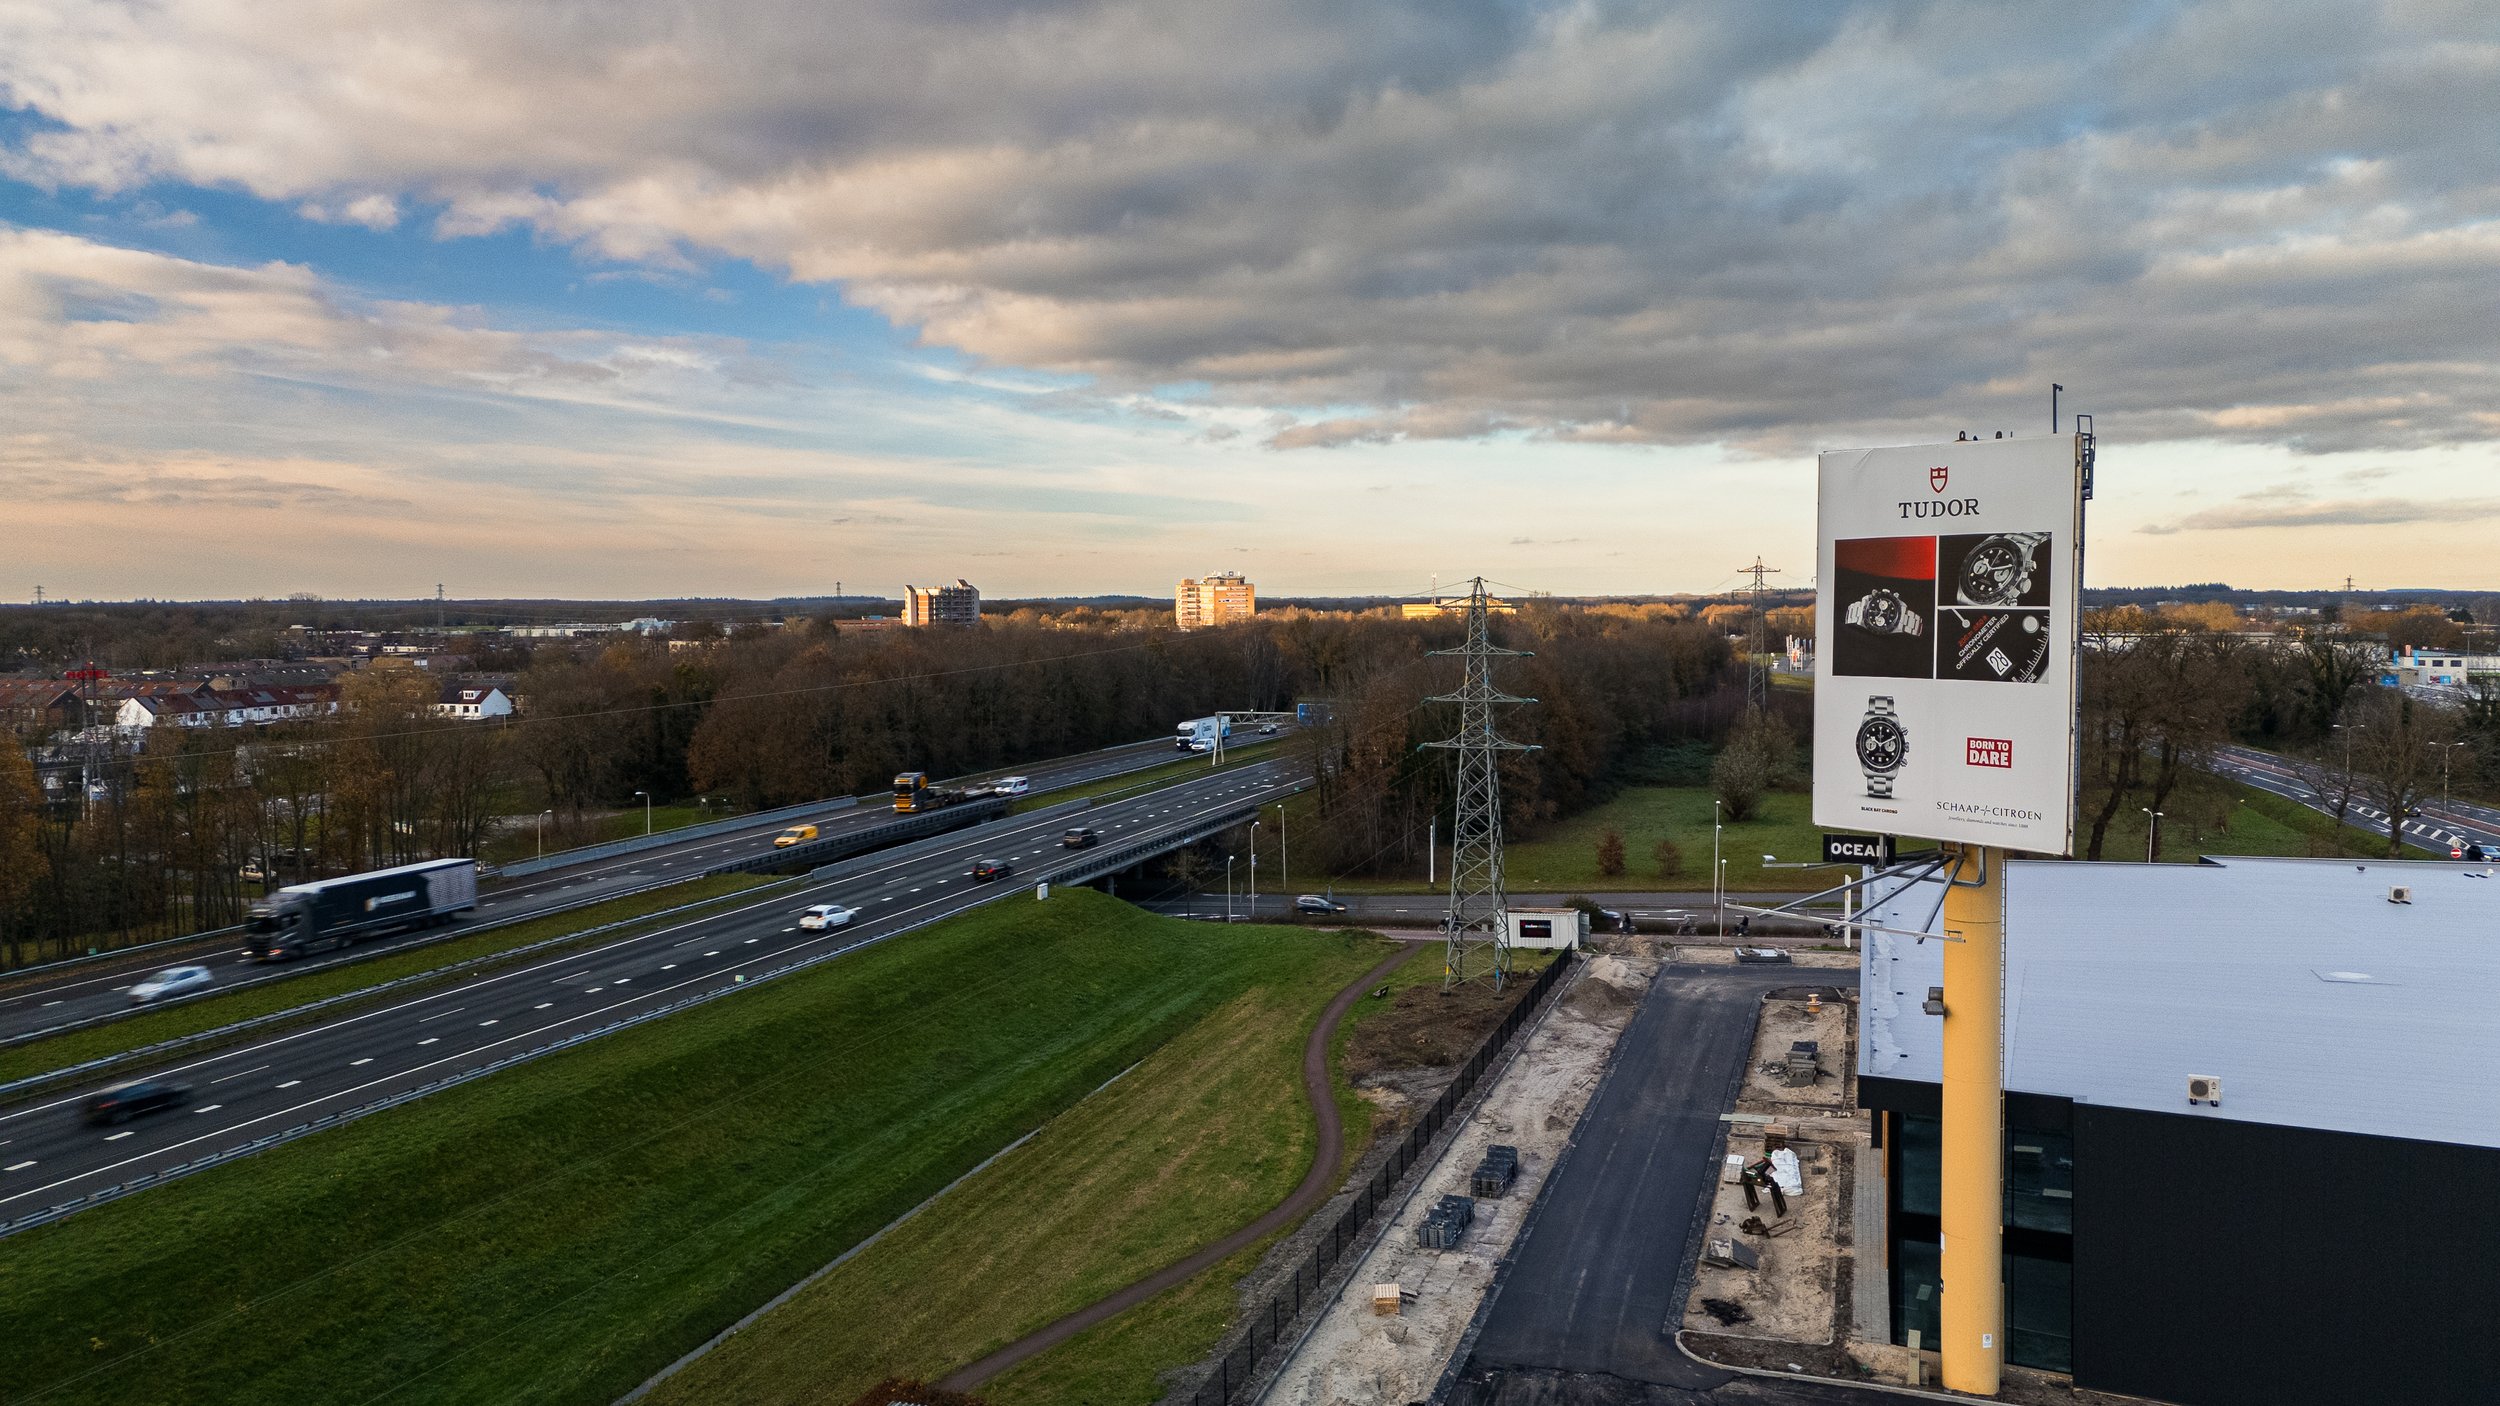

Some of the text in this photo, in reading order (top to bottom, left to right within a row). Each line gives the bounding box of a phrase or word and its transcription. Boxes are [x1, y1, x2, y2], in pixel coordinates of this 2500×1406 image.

[1898, 498, 1980, 519] TUDOR
[1956, 640, 1984, 670] OFFICIALLY
[1982, 613, 2010, 642] CERTIFIED
[1958, 616, 1997, 657] CHRONOMETER
[1988, 649, 2010, 674] 28
[1970, 740, 2009, 751] BORN TO
[1969, 749, 2009, 766] DARE
